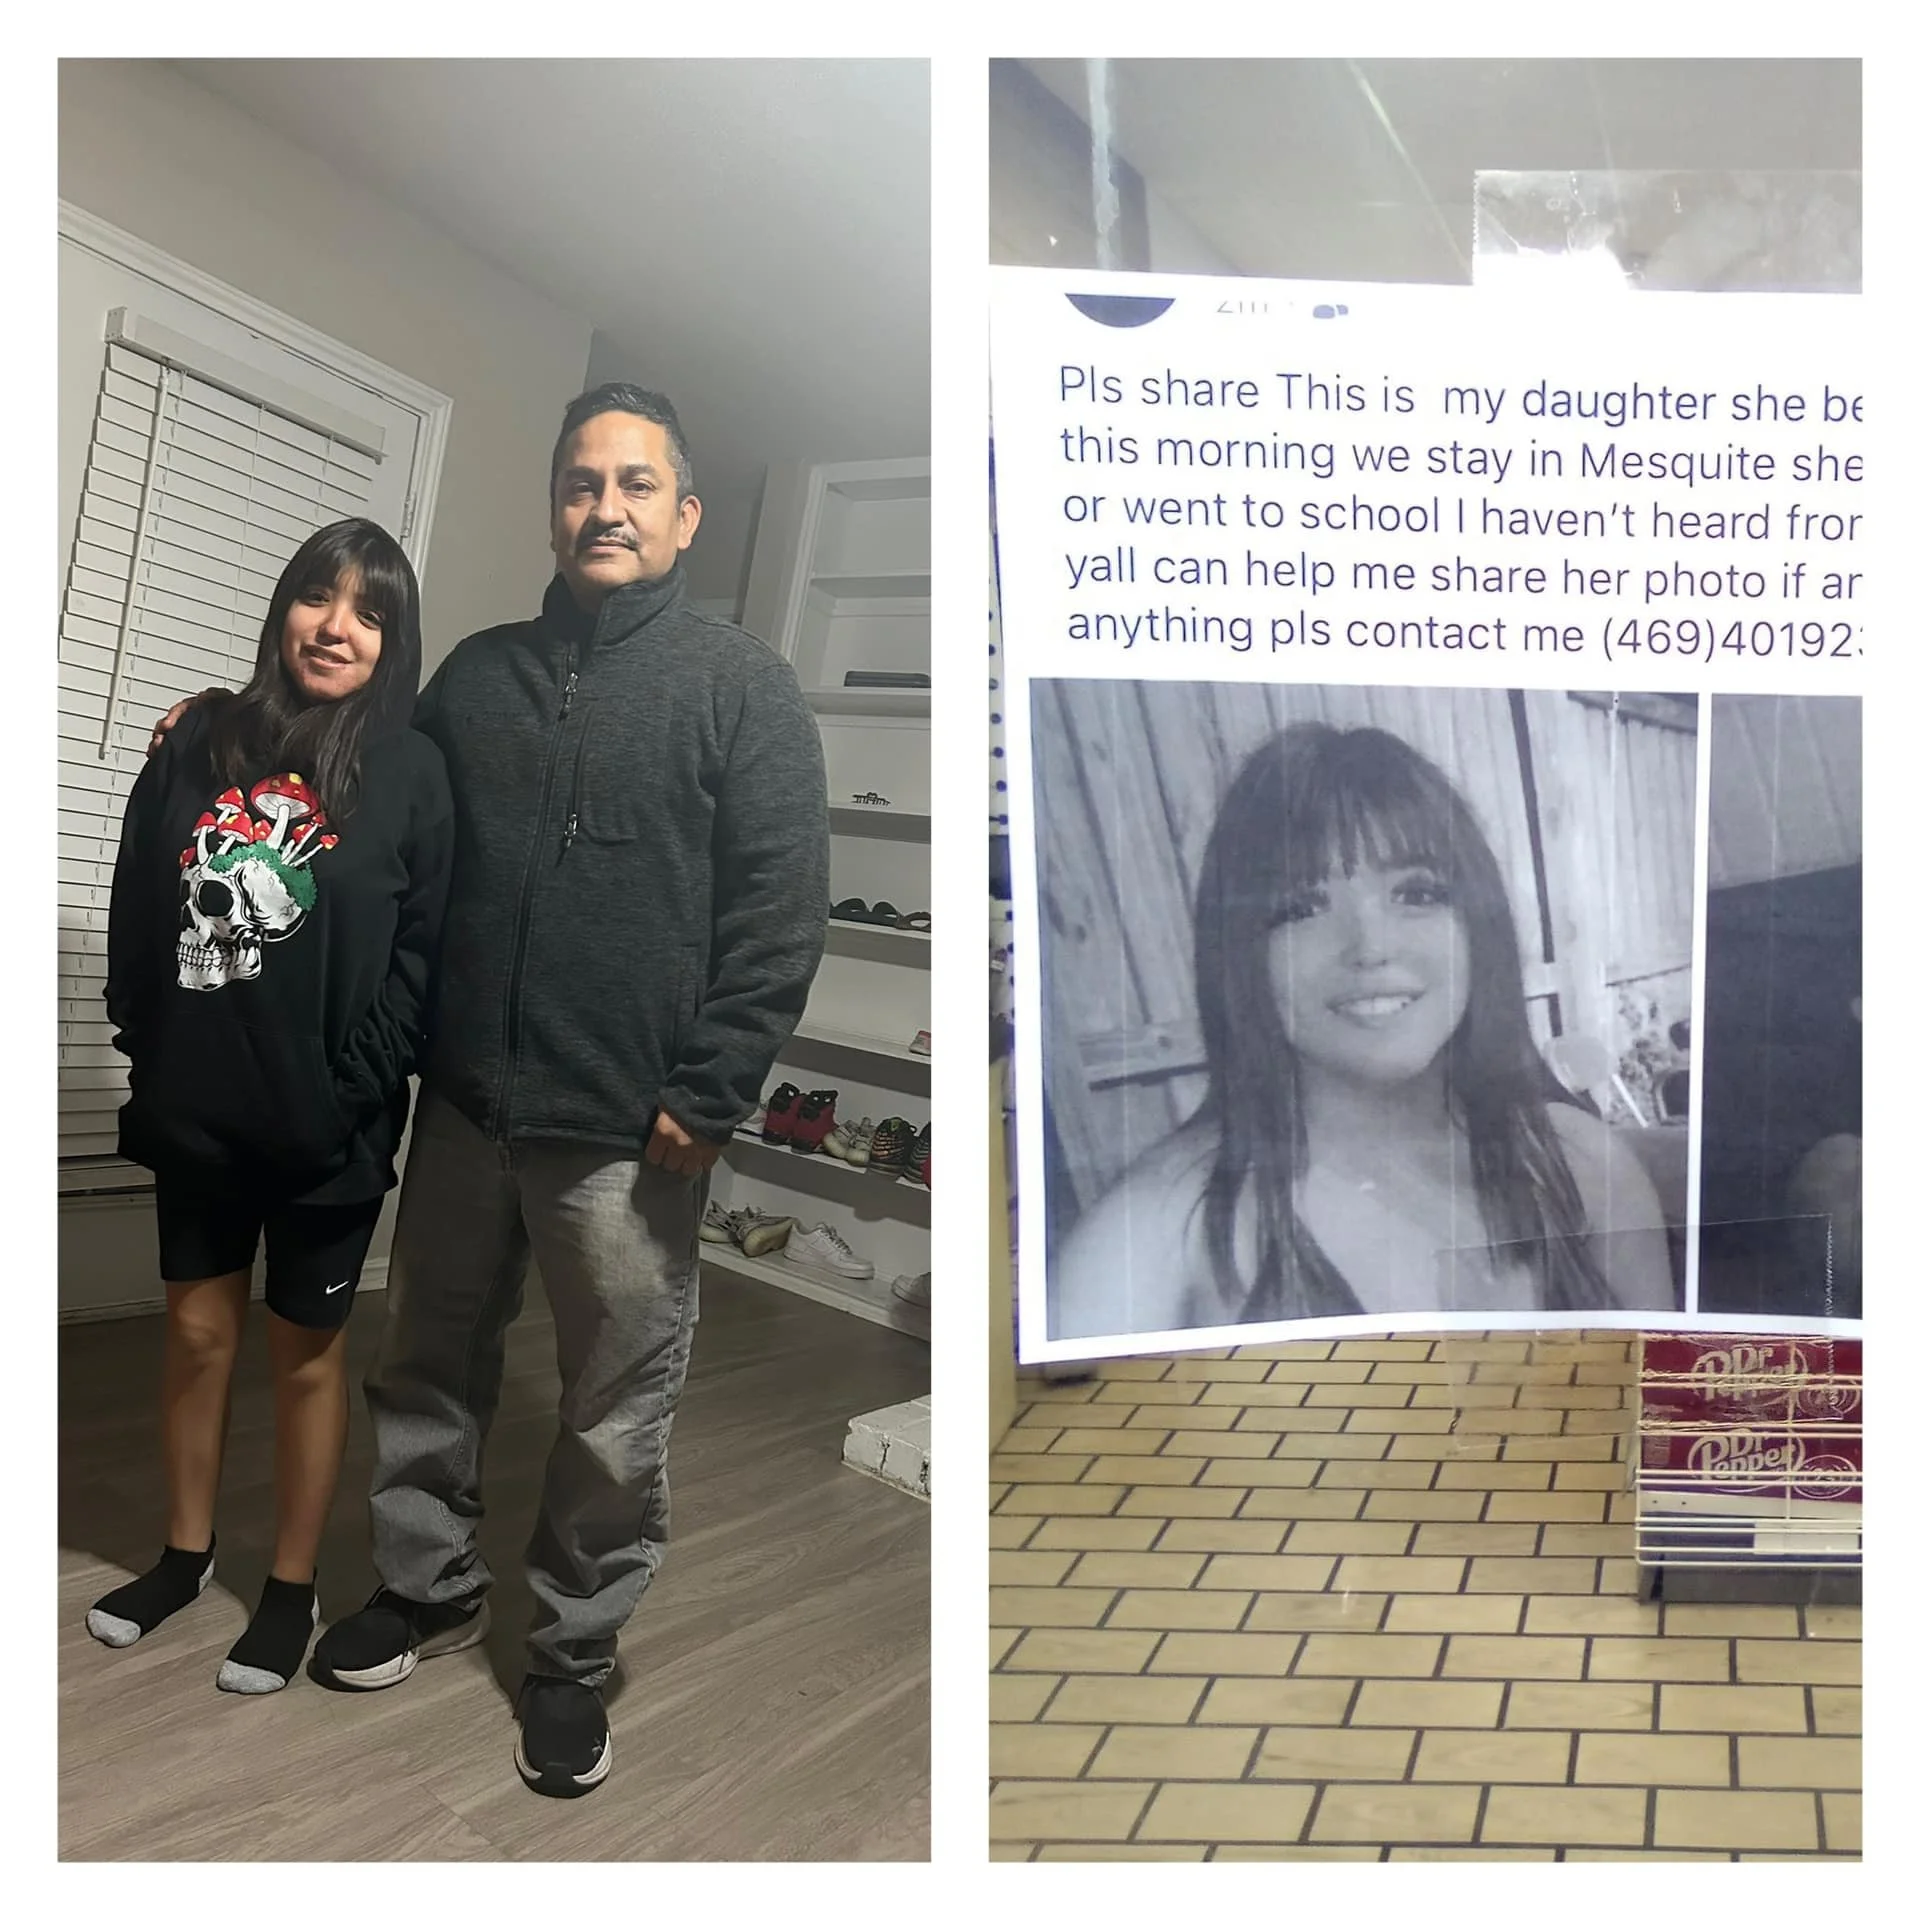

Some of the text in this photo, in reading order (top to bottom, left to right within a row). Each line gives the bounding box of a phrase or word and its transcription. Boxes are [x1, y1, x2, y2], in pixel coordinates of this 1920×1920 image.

[1060, 364, 1123, 404] Pls
[1141, 367, 1260, 409] share
[1275, 373, 1367, 412] This
[1383, 375, 1416, 414] is
[1444, 387, 1506, 425] my
[1522, 378, 1717, 428] daughter
[1731, 383, 1806, 422] she
[1059, 424, 1863, 489] this morning we stay in Mesquite she
[1063, 495, 1107, 523] or
[1122, 492, 1228, 528] went
[1241, 493, 1284, 529] to
[1300, 493, 1439, 534] school
[1457, 497, 1464, 534] I
[1482, 496, 1637, 538] haven't
[1653, 500, 1770, 540] heard
[1064, 545, 1136, 590] yall
[1153, 556, 1228, 586] can
[1246, 549, 1335, 597] help
[1353, 562, 1416, 592] me
[1431, 555, 1547, 594] share
[1563, 558, 1631, 597] her
[1644, 561, 1766, 605] photo
[1783, 561, 1808, 600] if
[1067, 605, 1863, 664] anything pls contact me (469)40192
[1701, 1435, 1797, 1482] Pepper
[1731, 1429, 1769, 1457] Dr
